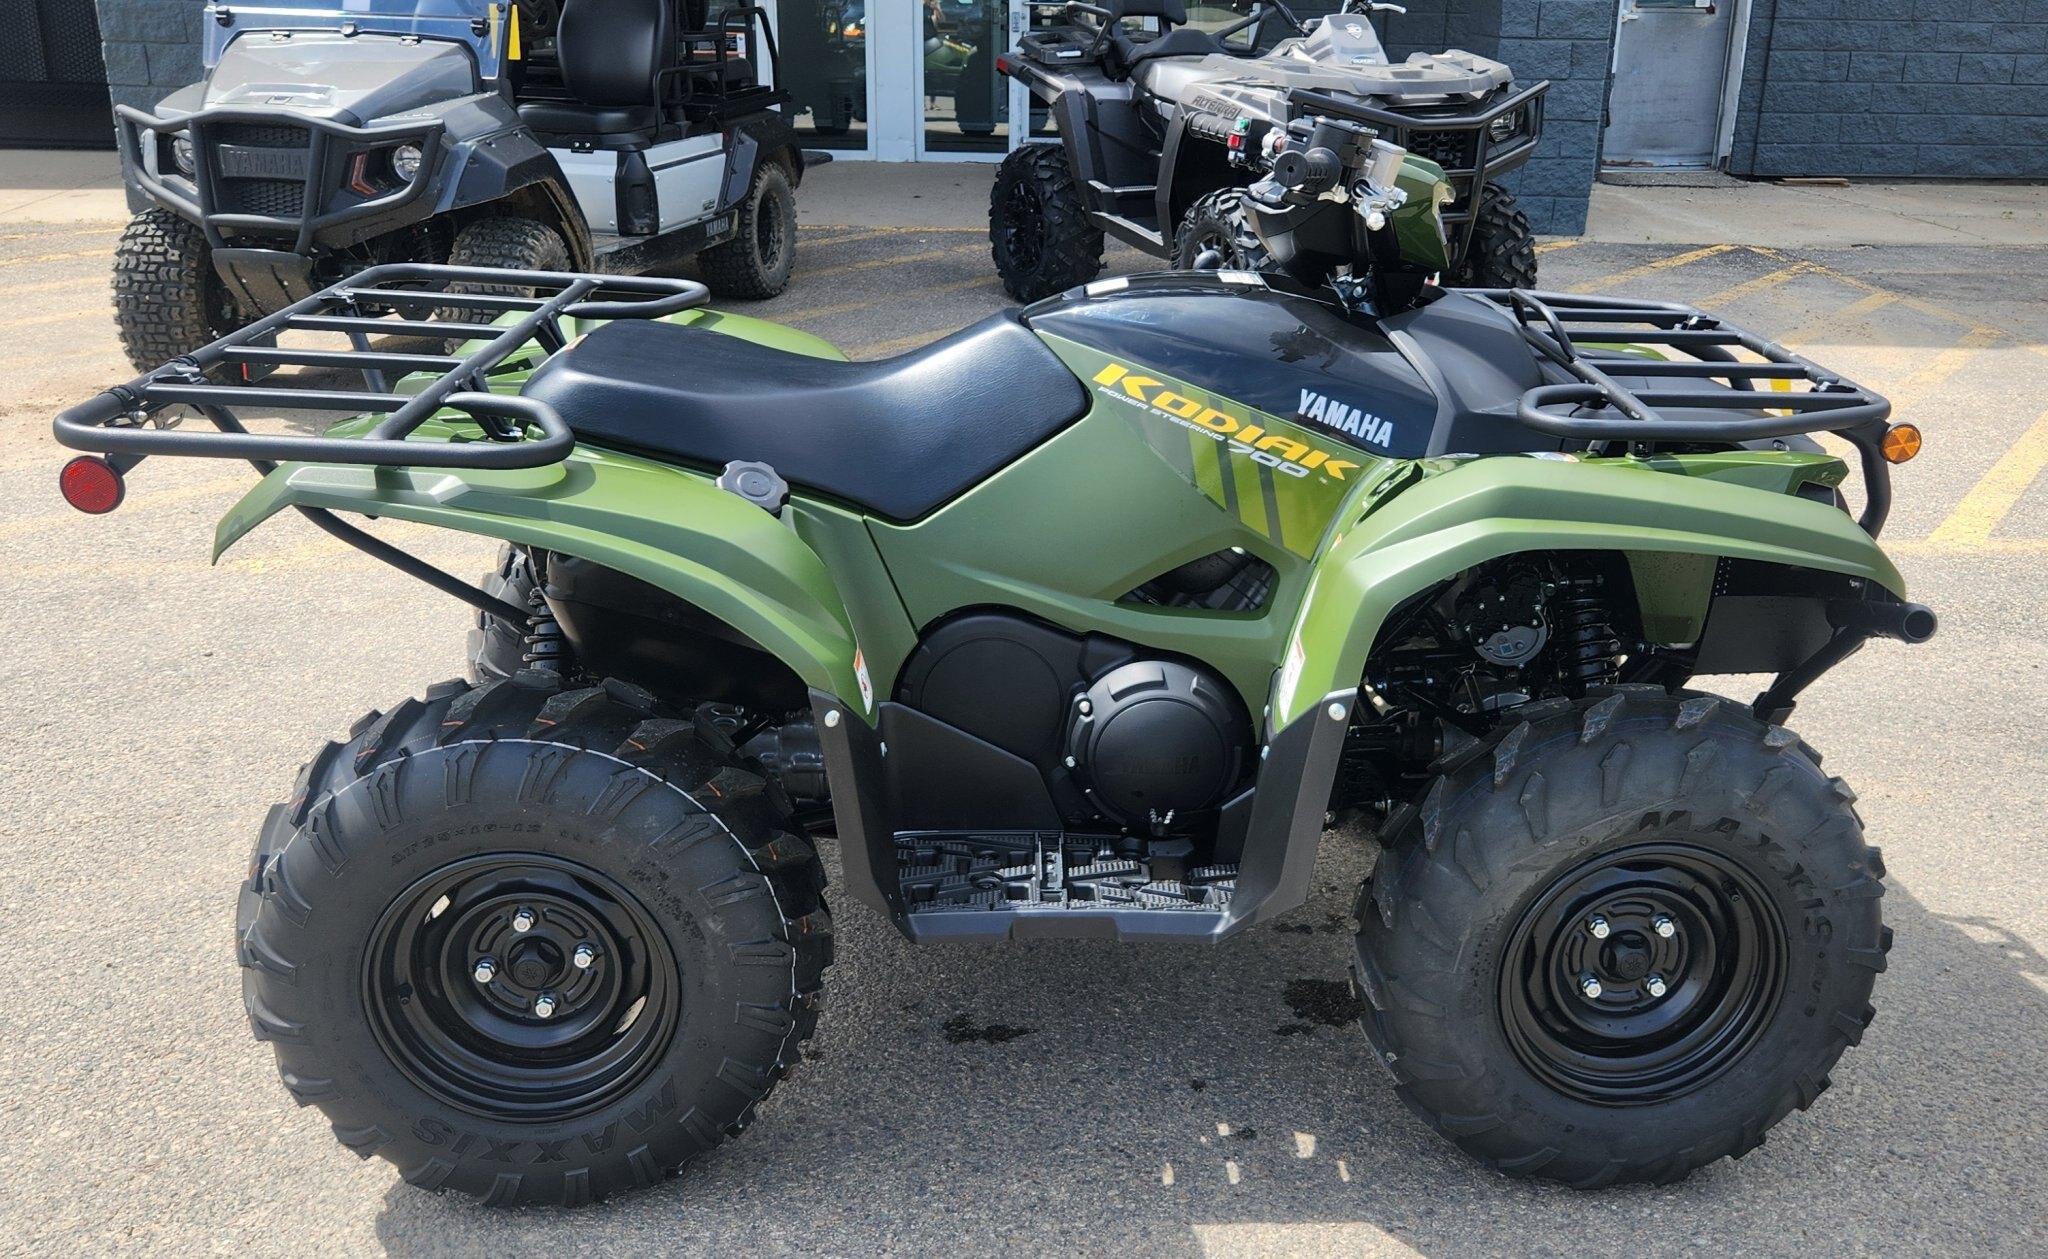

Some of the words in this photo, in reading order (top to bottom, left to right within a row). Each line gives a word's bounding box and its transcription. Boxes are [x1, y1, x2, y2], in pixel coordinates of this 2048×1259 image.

[1191, 95, 1239, 120] ALTERRA
[228, 151, 305, 178] YAMAHA
[1092, 363, 1360, 481] KODIAK
[1097, 386, 1149, 410] POWER
[1150, 408, 1226, 441] STEERING
[1297, 388, 1393, 448] YAMAHA
[1227, 439, 1310, 478] 700
[1638, 810, 1833, 946] MAXXIS
[410, 1074, 677, 1165] MAXXIS
